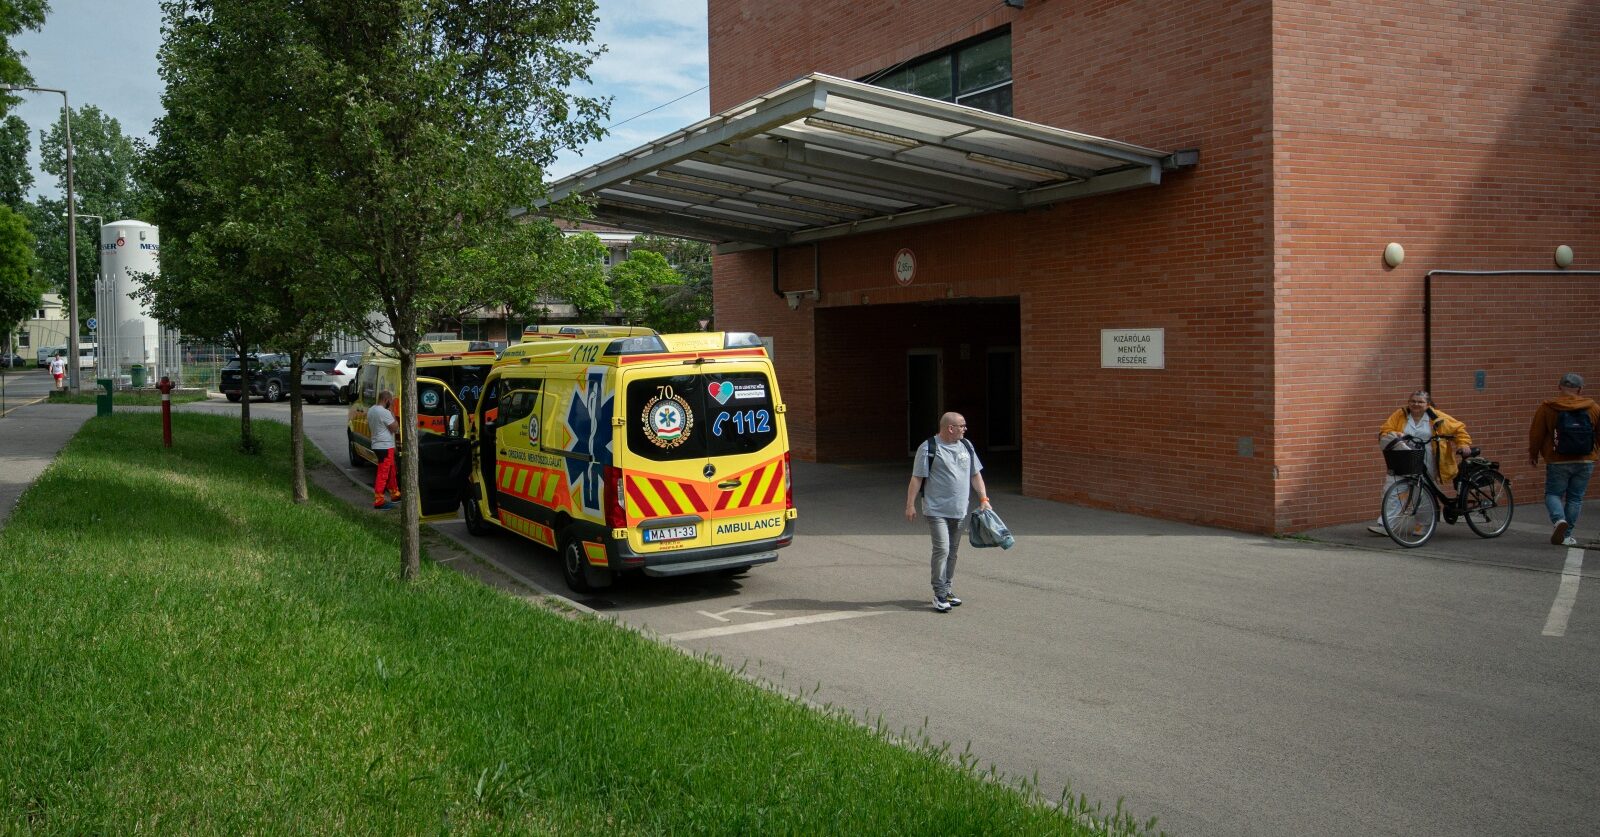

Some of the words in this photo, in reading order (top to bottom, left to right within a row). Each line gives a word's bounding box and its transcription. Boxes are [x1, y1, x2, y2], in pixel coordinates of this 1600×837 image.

[1113, 333, 1151, 343] KIZÁRÓLAG
[583, 345, 599, 363] 112
[1118, 344, 1146, 353] MENTŐK
[1117, 355, 1148, 364] RÉSZÉRE
[656, 384, 674, 400] 70
[732, 409, 771, 434] 112
[651, 529, 666, 540] MA
[668, 526, 694, 538] 11-33
[716, 517, 781, 535] AMBULANCE
